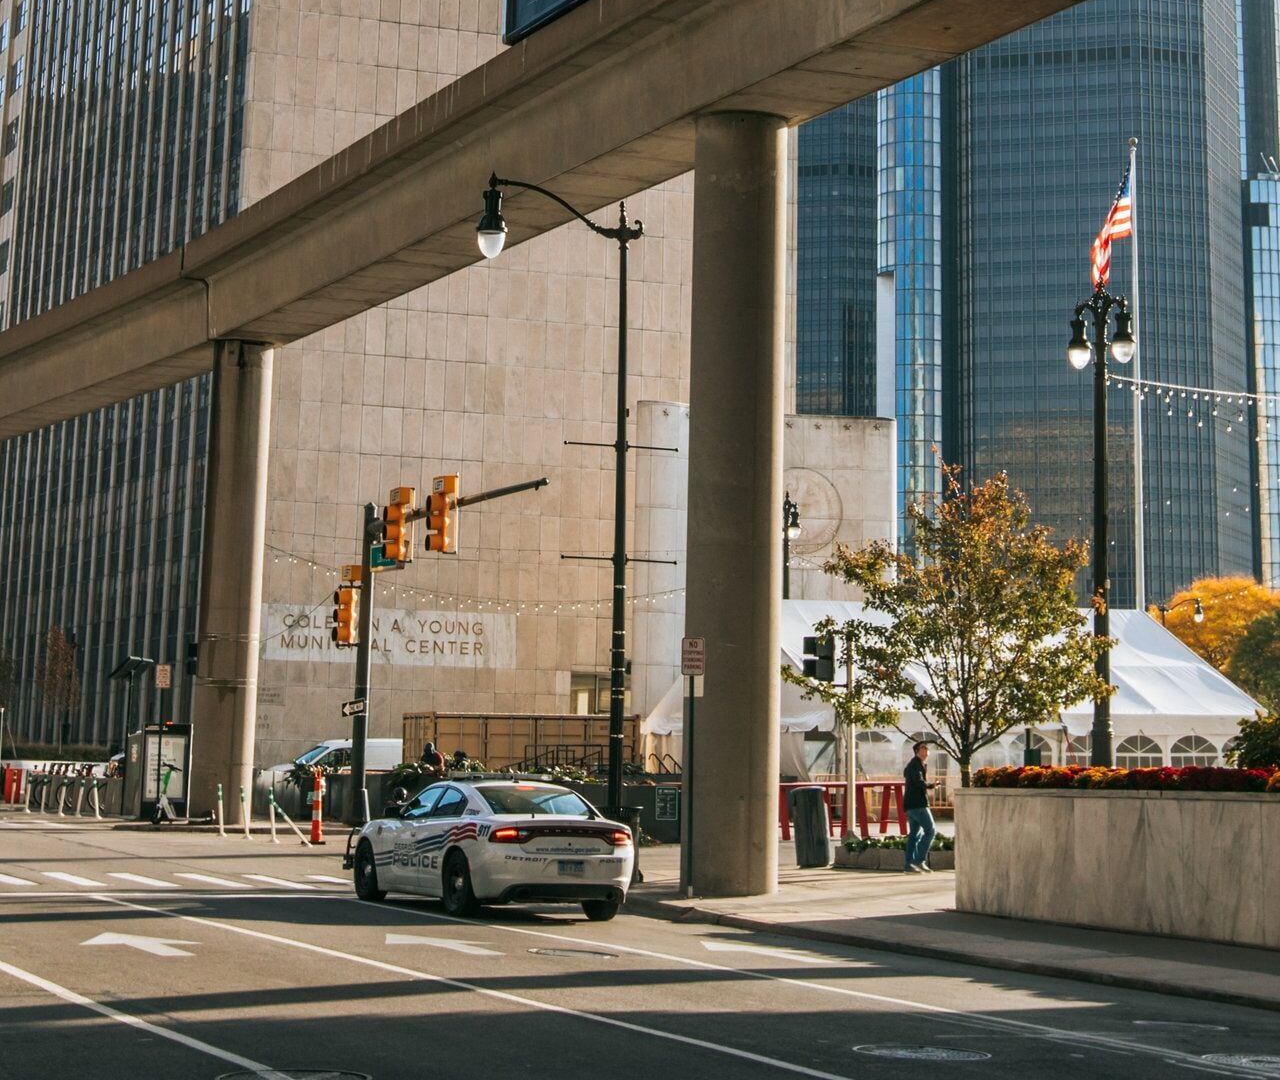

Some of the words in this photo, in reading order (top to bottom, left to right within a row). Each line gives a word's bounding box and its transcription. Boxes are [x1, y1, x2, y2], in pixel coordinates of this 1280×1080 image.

[283, 613, 379, 632] COLEN
[418, 619, 484, 636] YOUNG
[280, 634, 392, 653] MUNIAL
[405, 639, 484, 656] CENTER
[688, 641, 698, 649] NO
[477, 824, 492, 837] 911
[394, 842, 417, 850] DETROIT
[392, 852, 439, 869] POLICE
[504, 855, 549, 863] DETROIT
